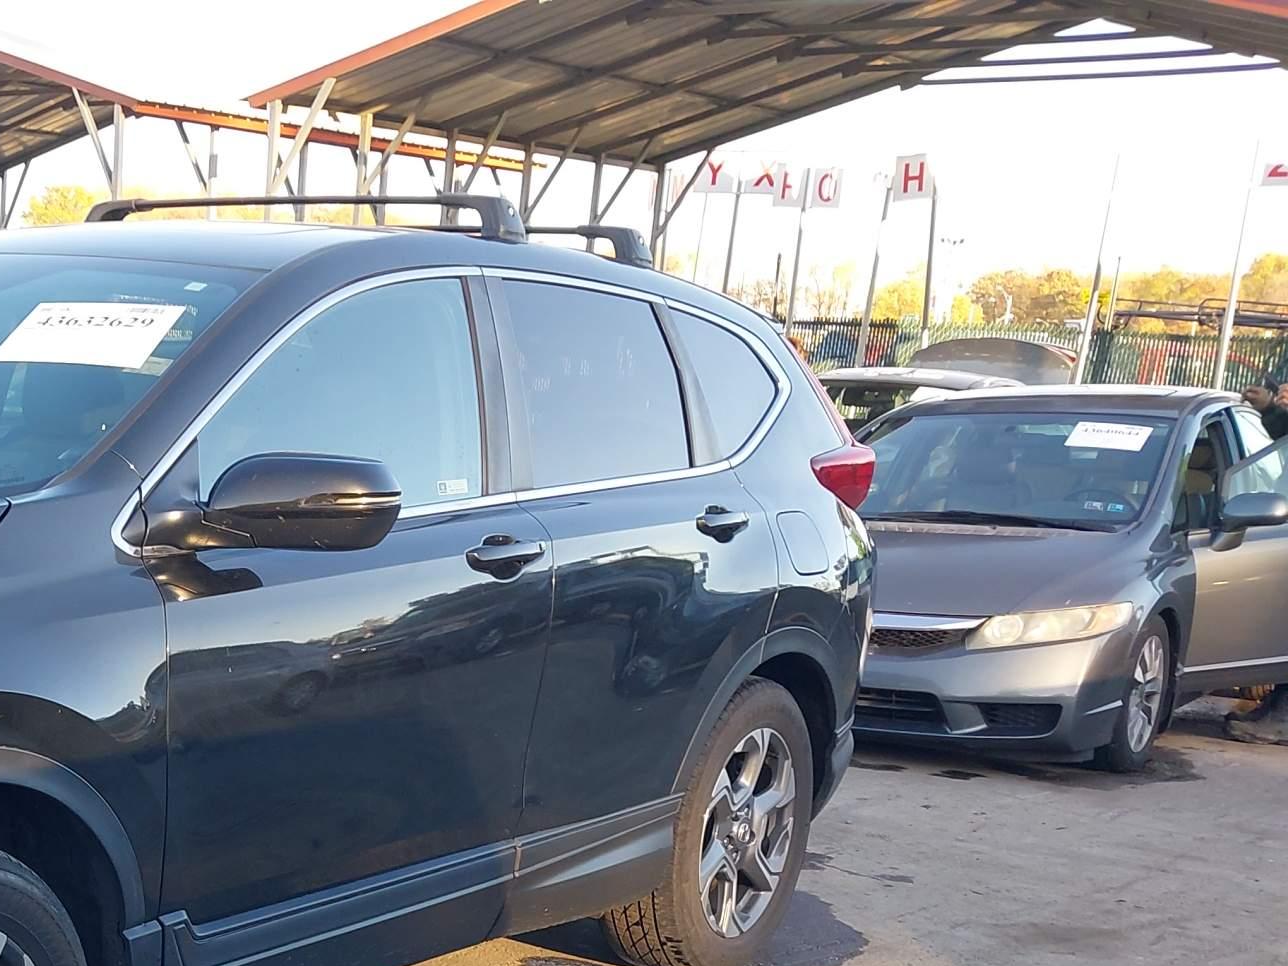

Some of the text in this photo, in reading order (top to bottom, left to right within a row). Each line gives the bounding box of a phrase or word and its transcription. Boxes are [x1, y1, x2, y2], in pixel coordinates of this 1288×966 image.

[708, 160, 725, 186] Y
[753, 160, 776, 187] X
[902, 161, 926, 193] H
[37, 316, 155, 328] 43632629
